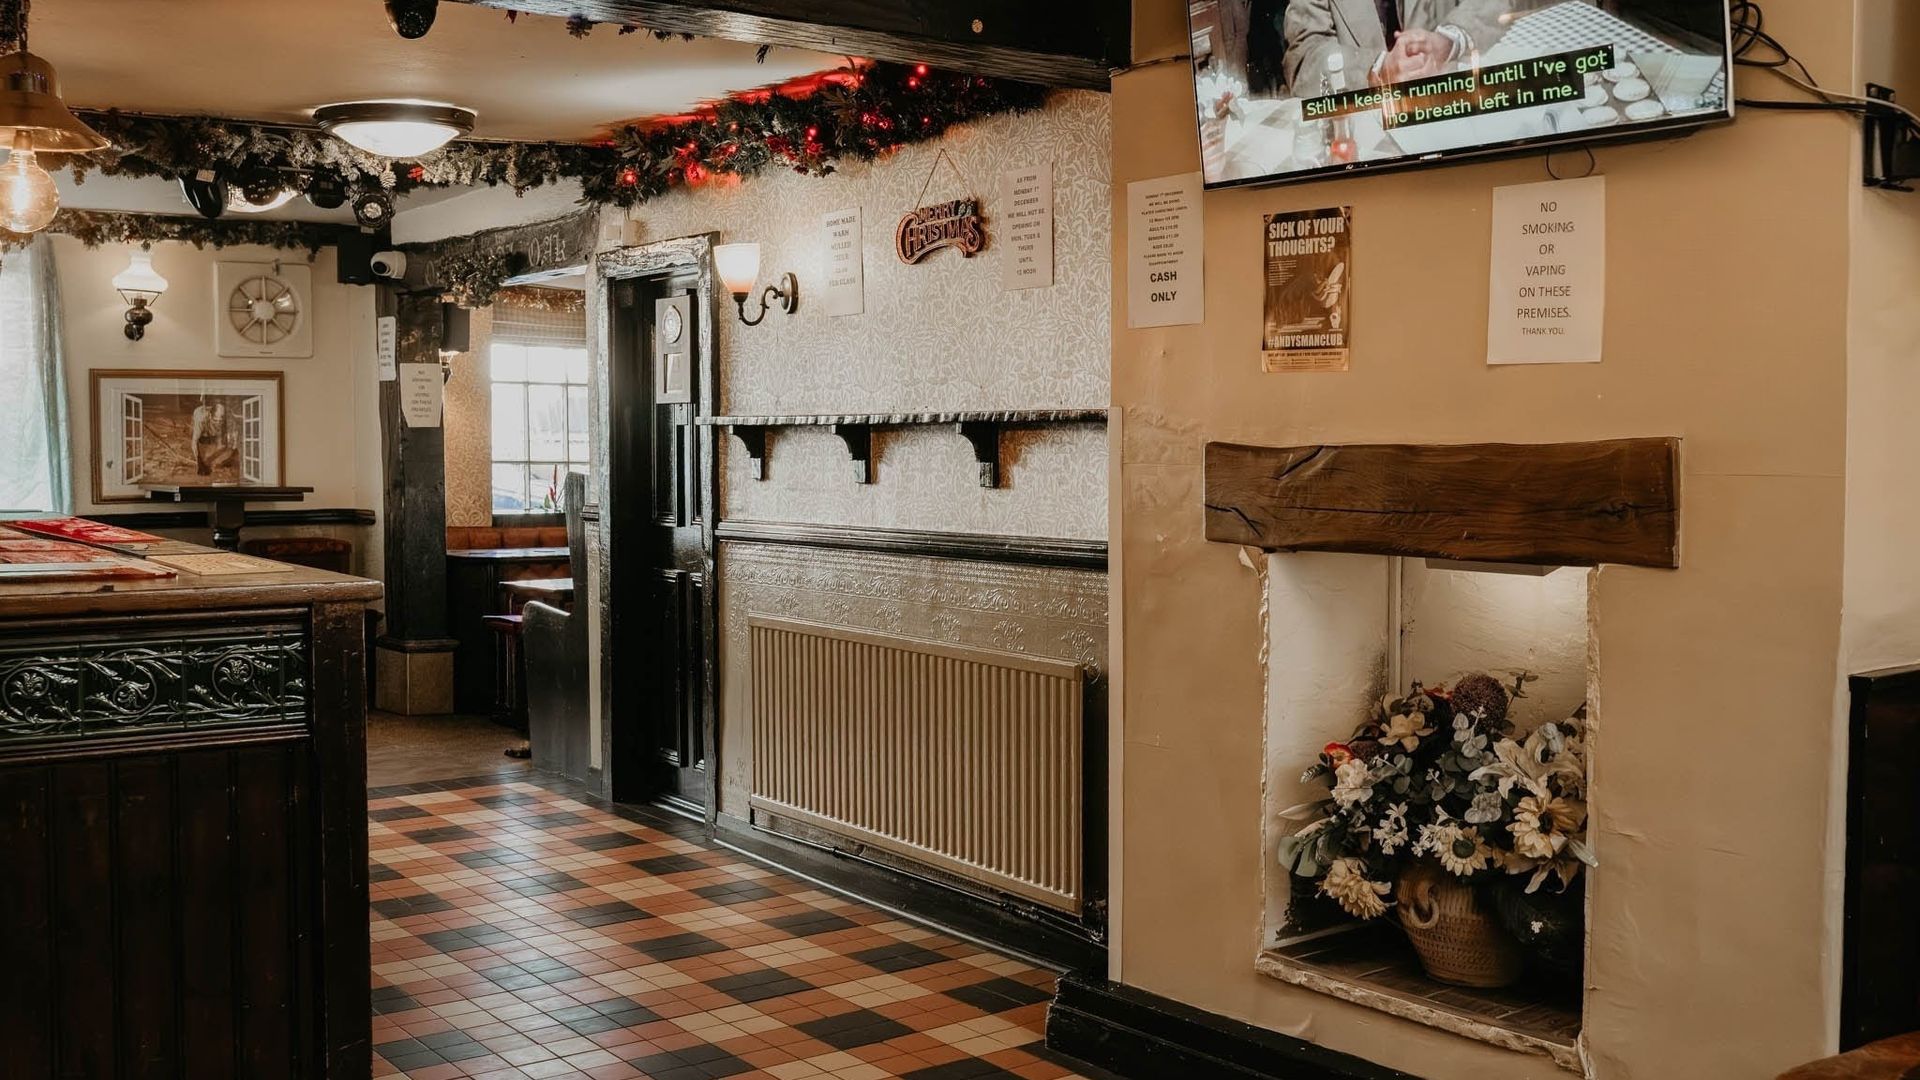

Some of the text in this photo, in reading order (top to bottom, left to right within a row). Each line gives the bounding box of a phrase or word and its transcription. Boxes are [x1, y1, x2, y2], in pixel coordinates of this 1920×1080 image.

[1306, 50, 1608, 117] Still I keeps running until I've got
[1387, 81, 1579, 125] no breath left in me.
[1014, 198, 1038, 207] DECEMBER
[1540, 201, 1557, 213] NO
[918, 201, 955, 223] MERRY
[841, 216, 855, 224] MADE
[1268, 216, 1345, 239] SICK OF YOUR
[1521, 221, 1575, 235] SMOKING
[896, 215, 980, 265] CHRISTMAS
[1268, 236, 1336, 257] THOUGHTS?
[1538, 243, 1555, 255] OR
[1150, 271, 1177, 283] CASH
[1525, 264, 1567, 277] VAPING
[1150, 291, 1177, 303] ONLY
[1518, 285, 1572, 298] ON THESE
[1517, 306, 1572, 319] PREMISES.
[1521, 327, 1546, 336] THANK
[1267, 333, 1343, 349] #ANDYSMANCLUB
